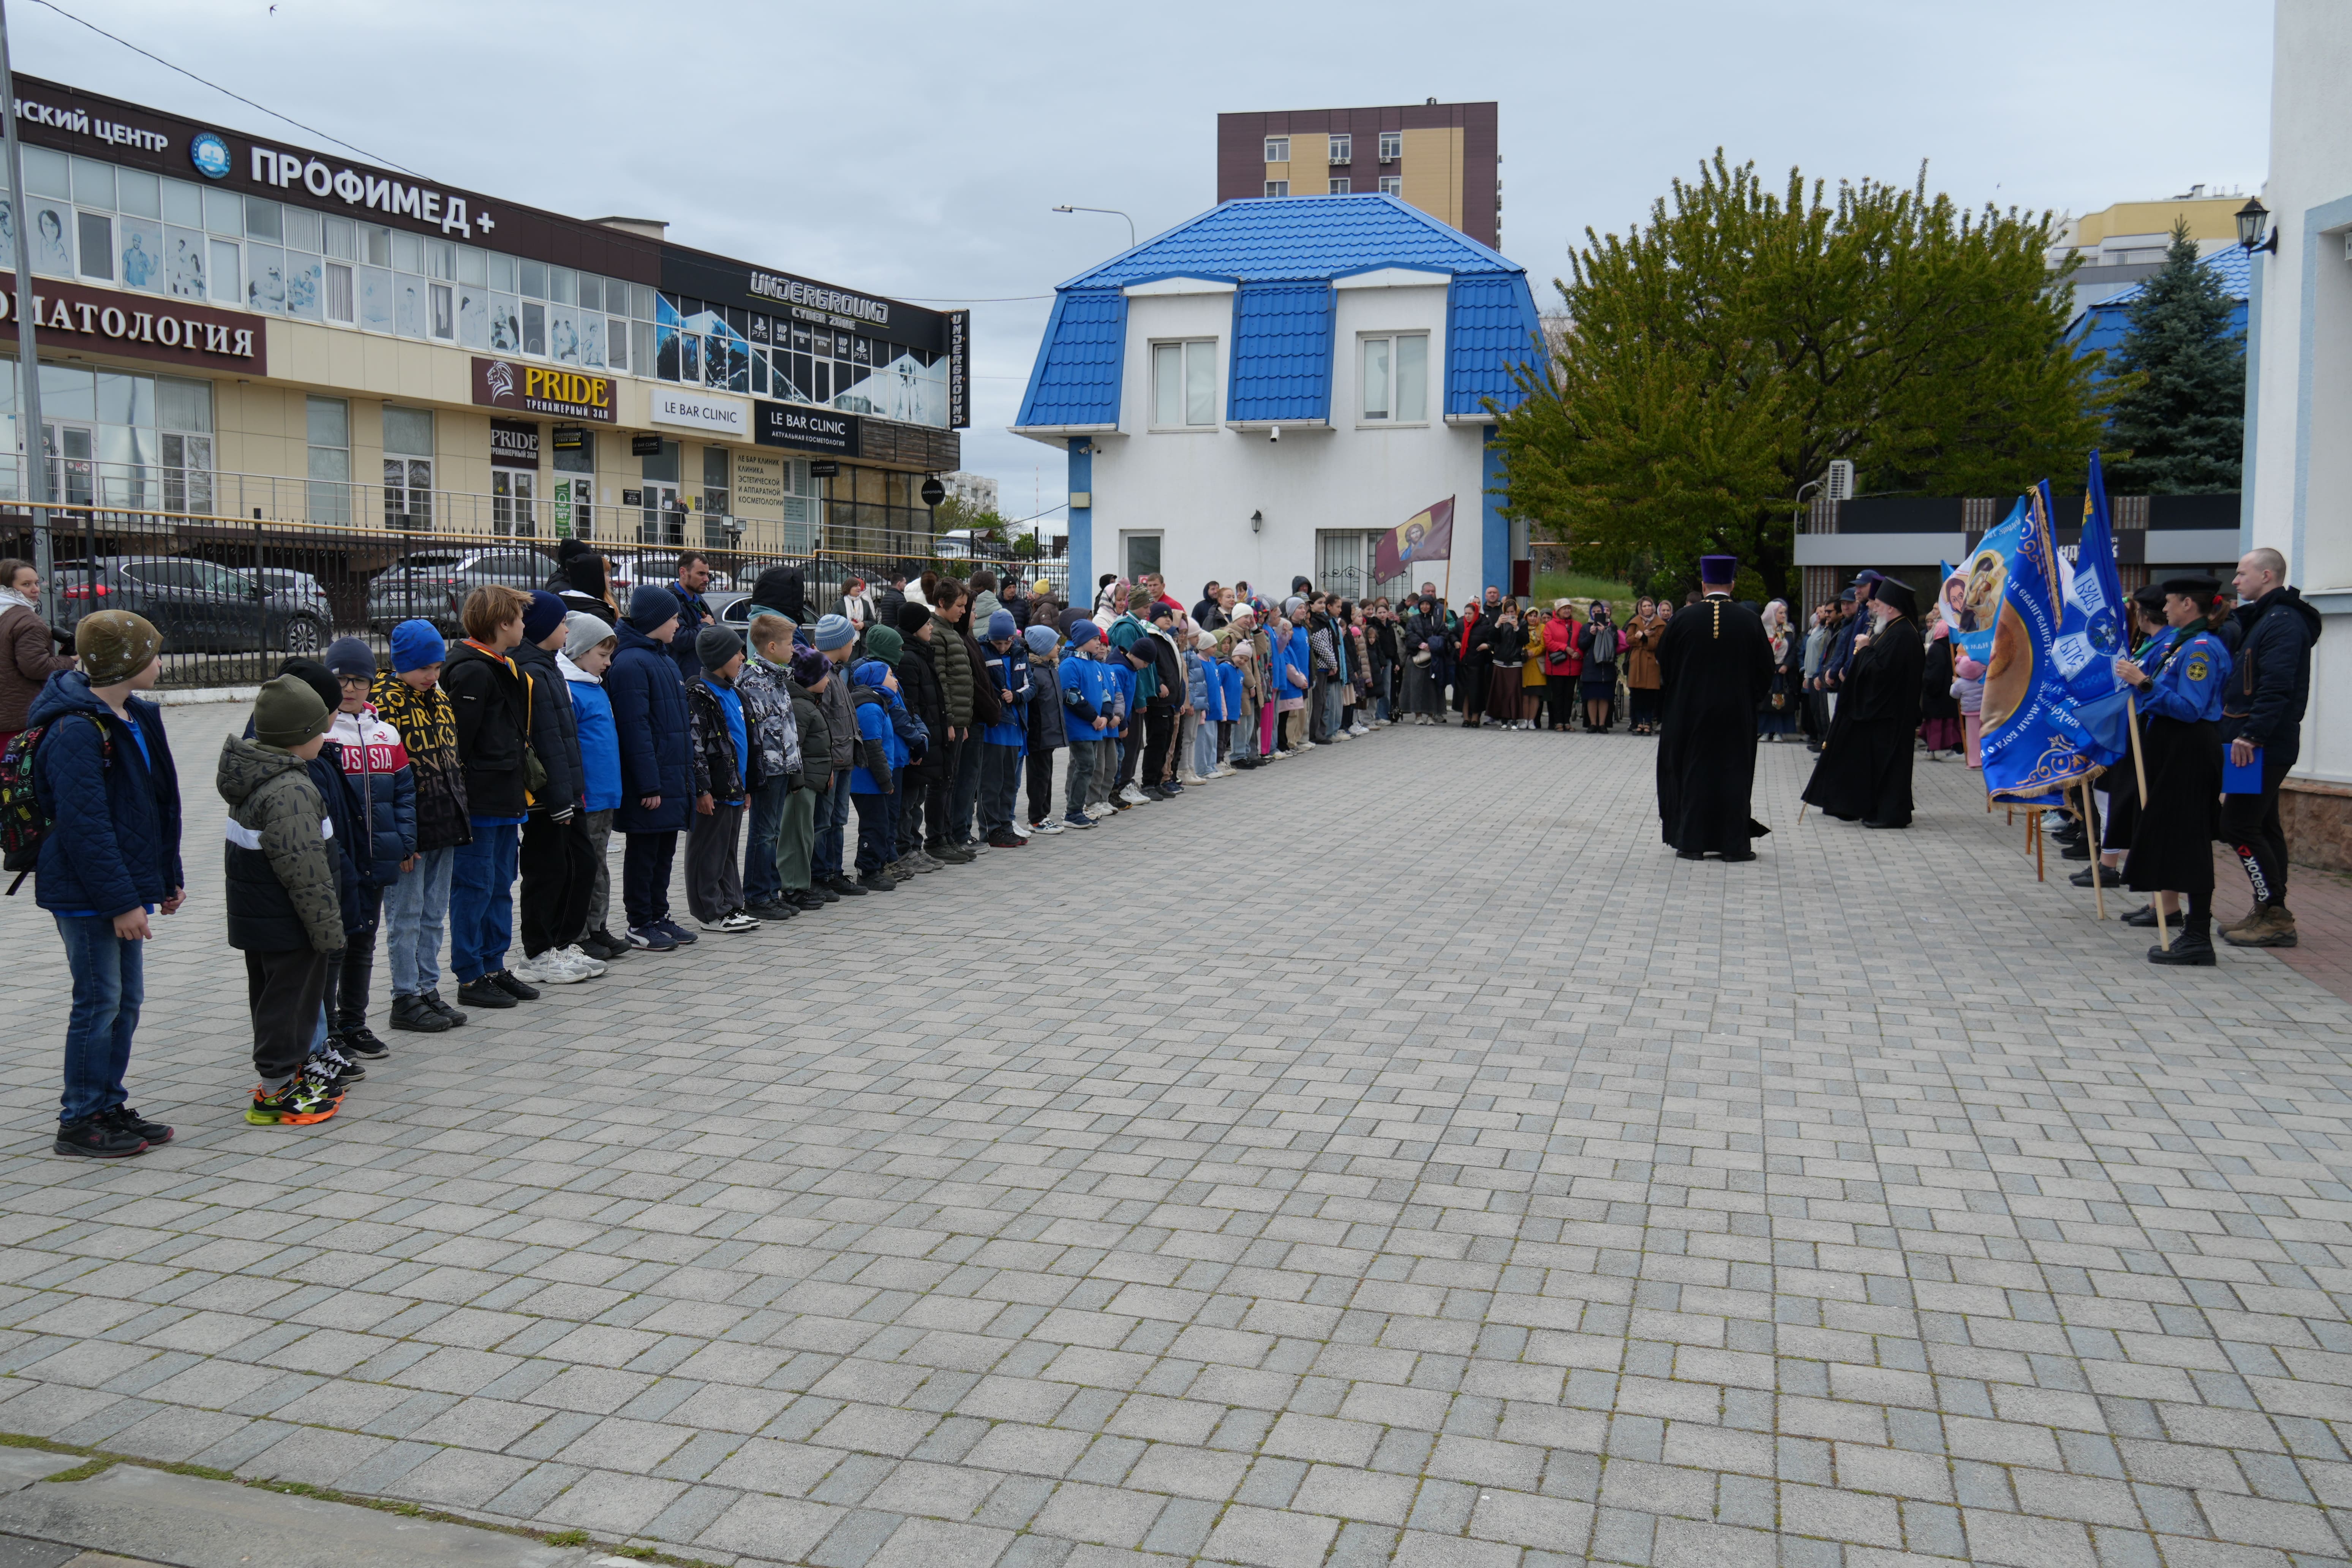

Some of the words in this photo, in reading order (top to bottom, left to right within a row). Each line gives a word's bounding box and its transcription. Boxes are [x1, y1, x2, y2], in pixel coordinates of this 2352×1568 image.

[95, 119, 168, 152] ЦЕНТР
[196, 134, 227, 150] PROFIMED
[251, 147, 470, 239] ПРОФИМЕД
[750, 271, 888, 324] UNDERGROUND
[792, 307, 826, 324] CYBER
[828, 316, 856, 330] ZONE
[752, 330, 768, 339] PS5
[777, 324, 787, 334] VIP
[793, 330, 811, 340] МОЩНЫЕ
[838, 337, 848, 346] VIP
[952, 315, 962, 425] UNDERGROUND
[524, 367, 609, 408] PRIDE
[526, 399, 588, 417] ТРЕНАЖЕРНЫЙ
[593, 408, 608, 420] ЗАЛ
[665, 401, 676, 414] LE
[680, 404, 699, 417] BAR
[702, 407, 737, 423] CLINIC
[771, 411, 783, 425] LE
[786, 414, 807, 430] BAR
[810, 418, 846, 435] CLINIC
[491, 429, 539, 451] PRIDE
[771, 430, 805, 441] АКТУАЛЬНАЯ
[805, 435, 845, 447] КОСМЕТОЛОГИЯ
[527, 451, 537, 460] ЗАЛ
[758, 457, 779, 466] КЛИНИК
[738, 465, 764, 475] КЛИНИКА
[738, 476, 780, 486] ЭСТЕТИЧЕСКОЙ
[743, 487, 781, 496] АППАРАТНОЙ
[738, 496, 784, 506] КОСМЕТОЛОГИИ
[2075, 578, 2101, 612] БУДЬ
